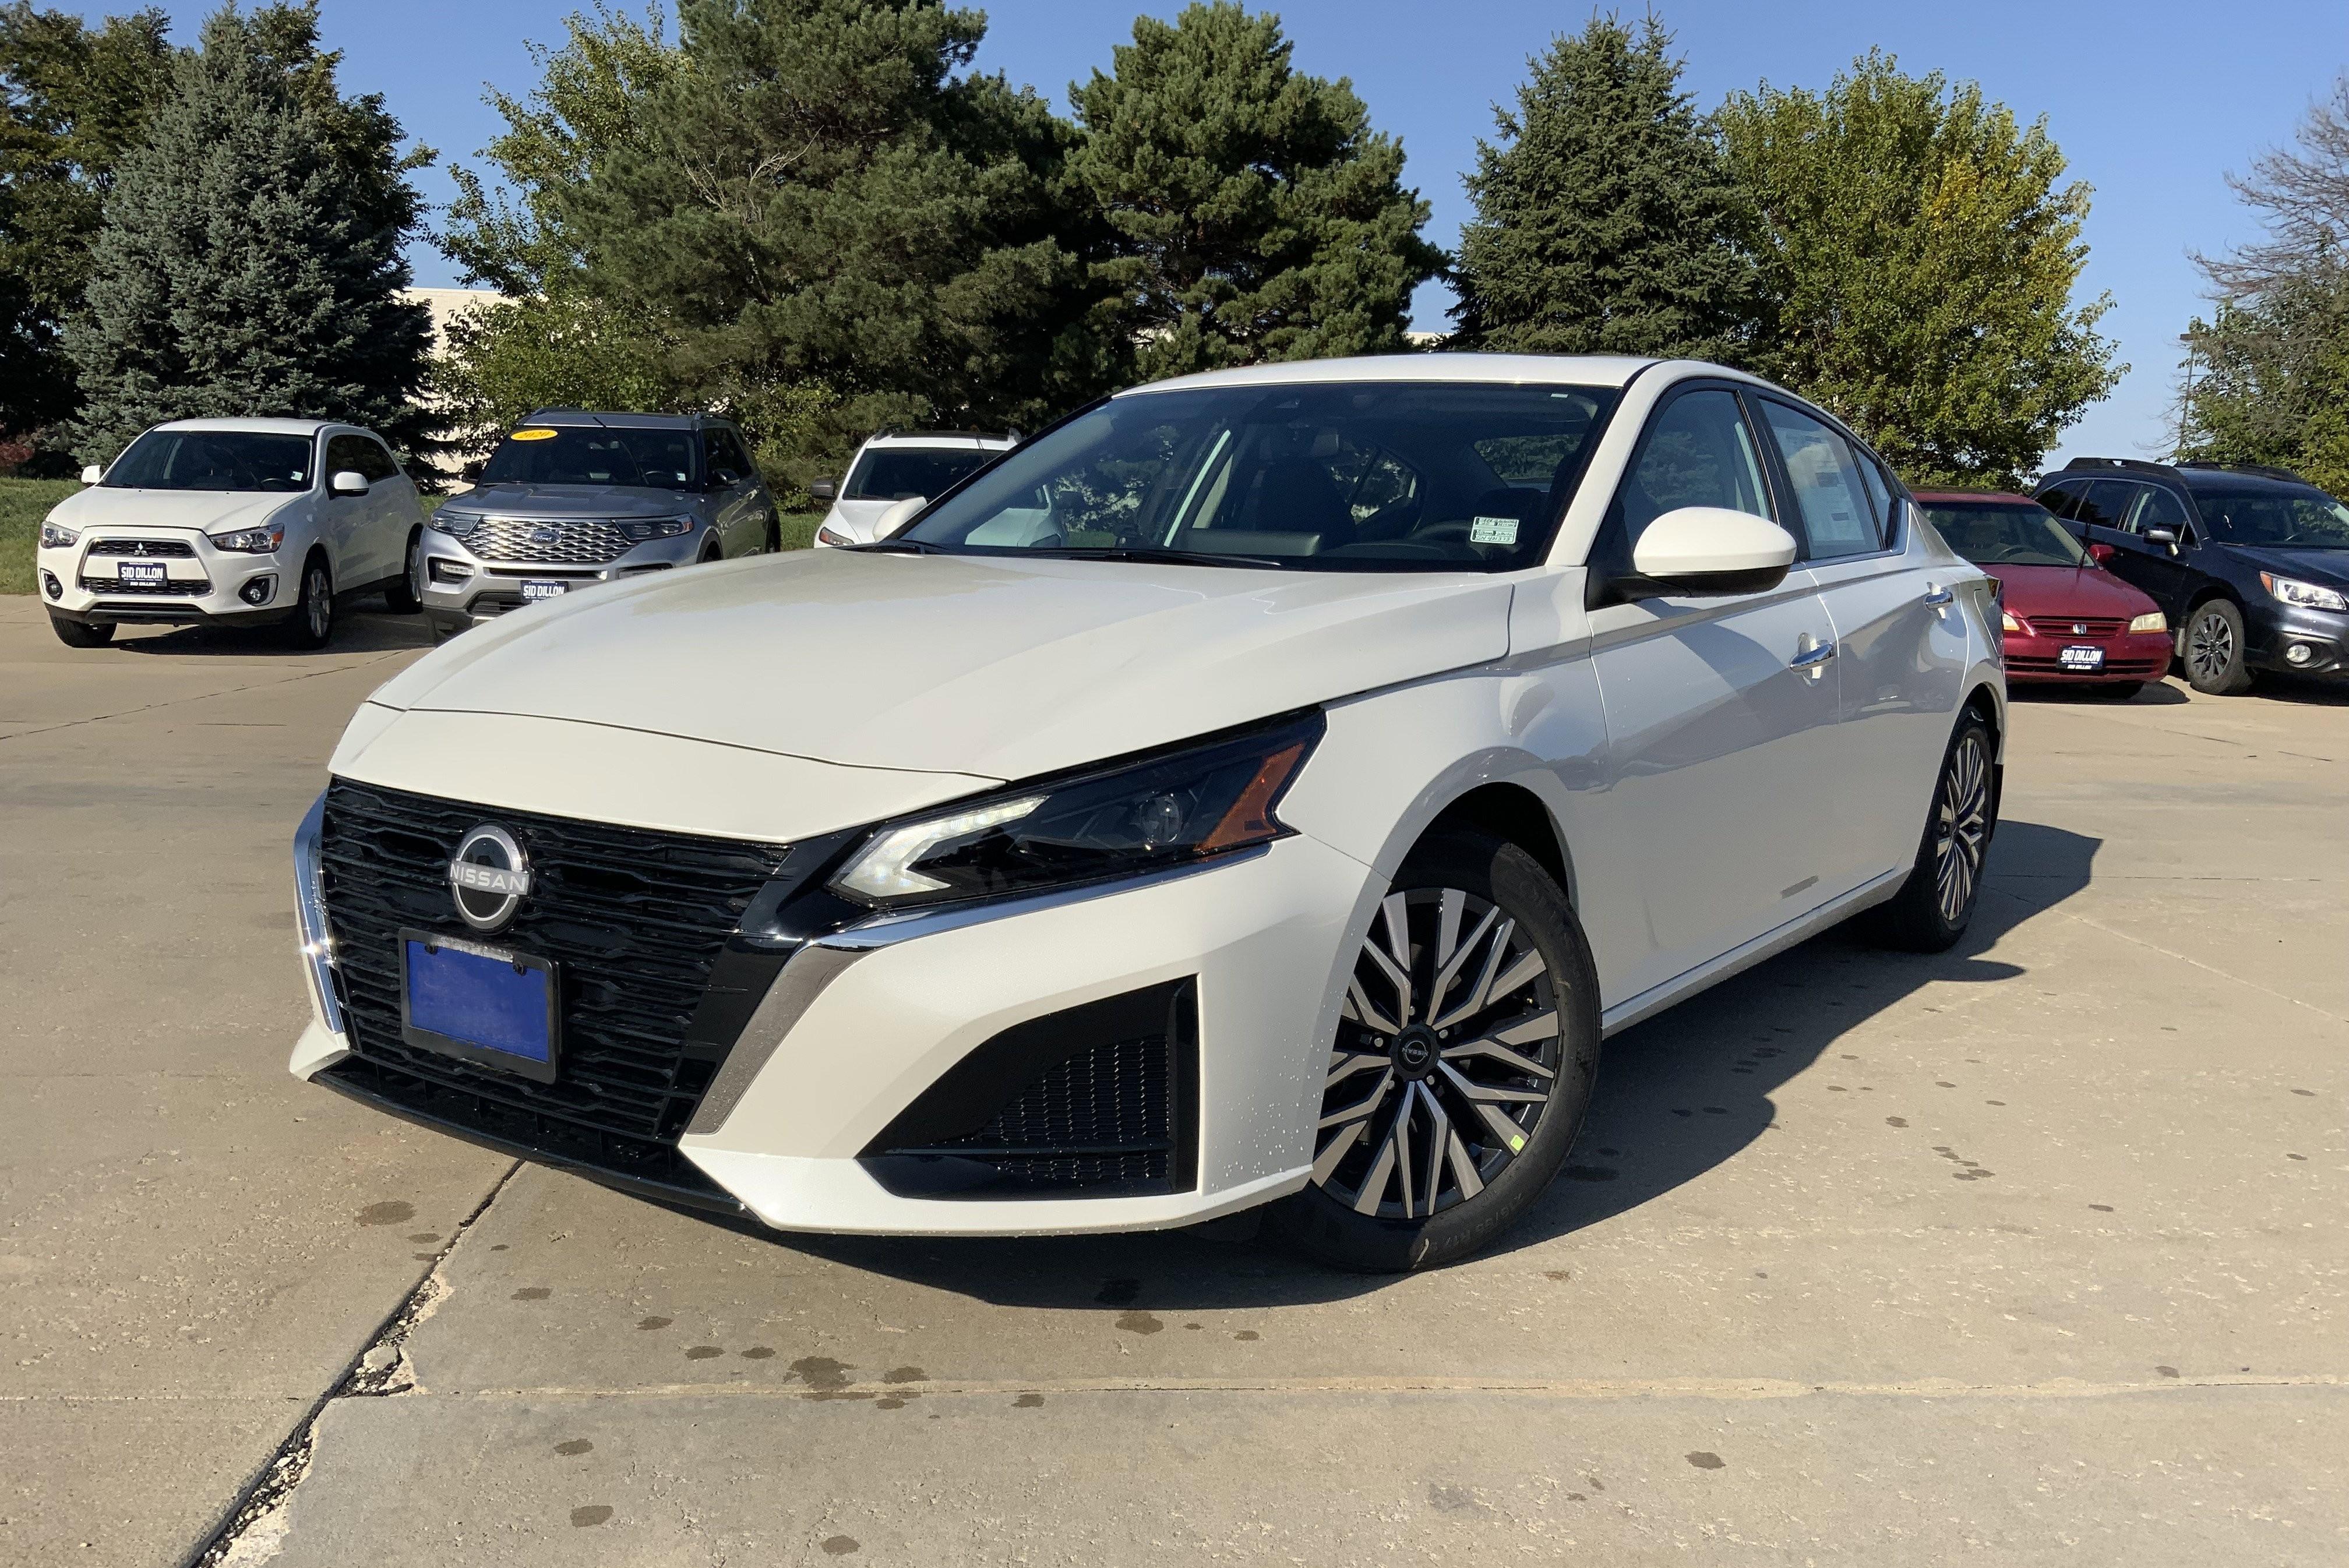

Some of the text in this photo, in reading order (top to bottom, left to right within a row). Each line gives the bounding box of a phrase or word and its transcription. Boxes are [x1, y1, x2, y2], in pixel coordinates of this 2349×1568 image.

[121, 567, 163, 579] SID DILLON
[523, 585, 565, 596] SID DILLON
[2061, 649, 2103, 662] SID DILLON
[450, 863, 527, 892] NISSAN
[1402, 1048, 1428, 1056] NISSAN
